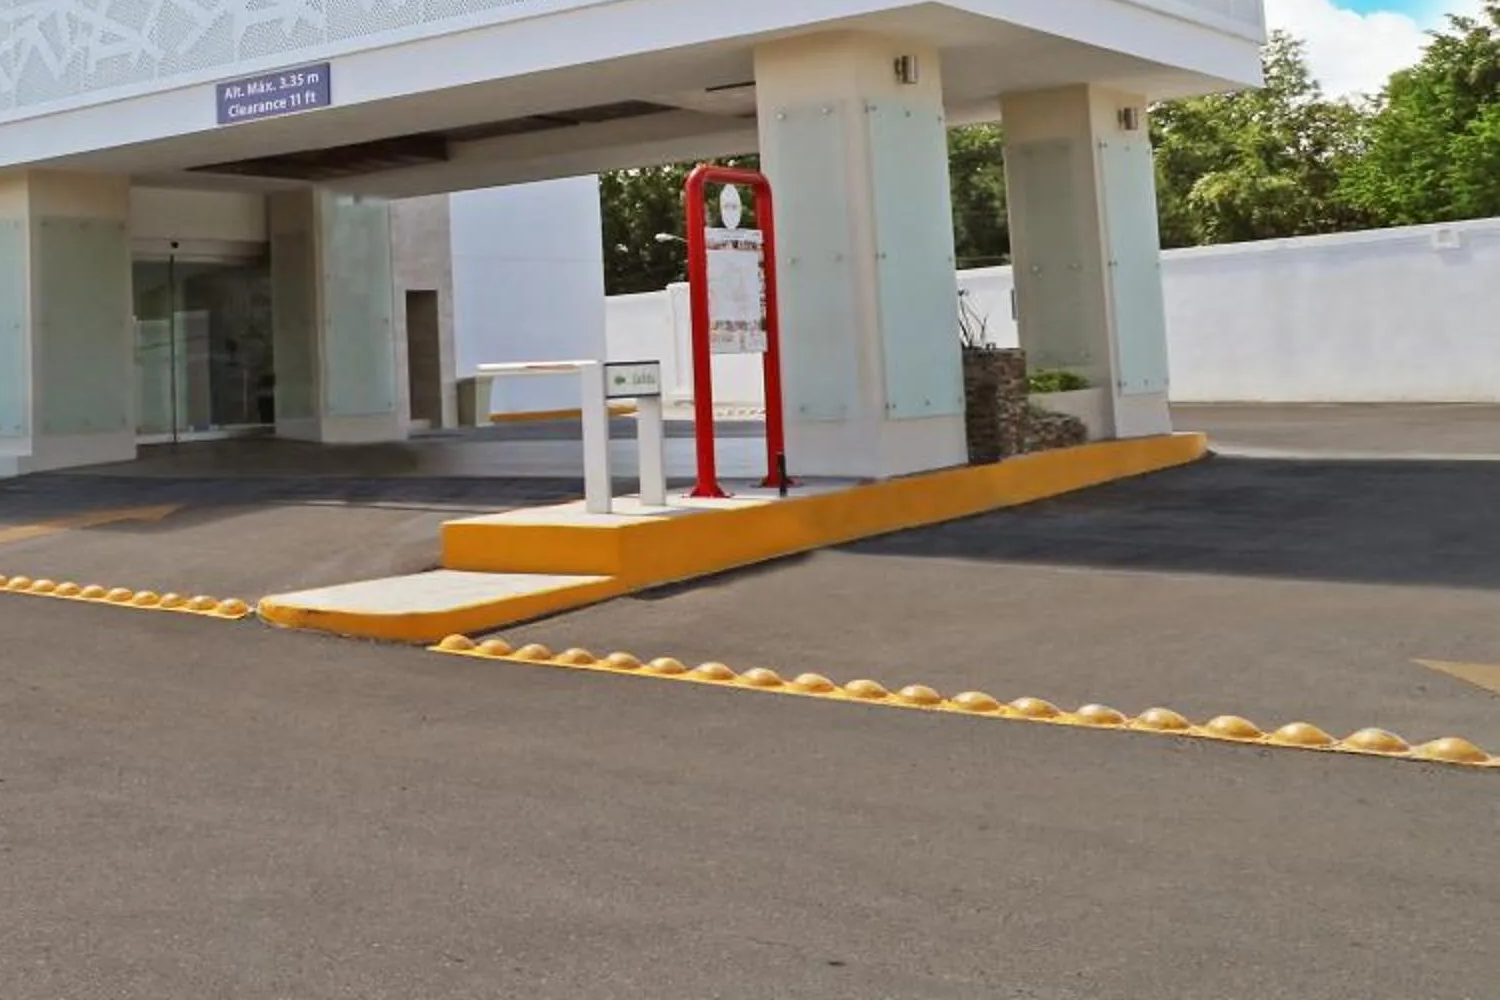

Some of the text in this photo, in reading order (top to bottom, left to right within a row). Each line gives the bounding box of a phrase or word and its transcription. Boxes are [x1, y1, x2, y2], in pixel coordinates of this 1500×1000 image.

[224, 86, 245, 100] Alt.
[280, 73, 305, 90] 3.35
[307, 73, 319, 84] m
[228, 90, 317, 118] Clearance 11 ft
